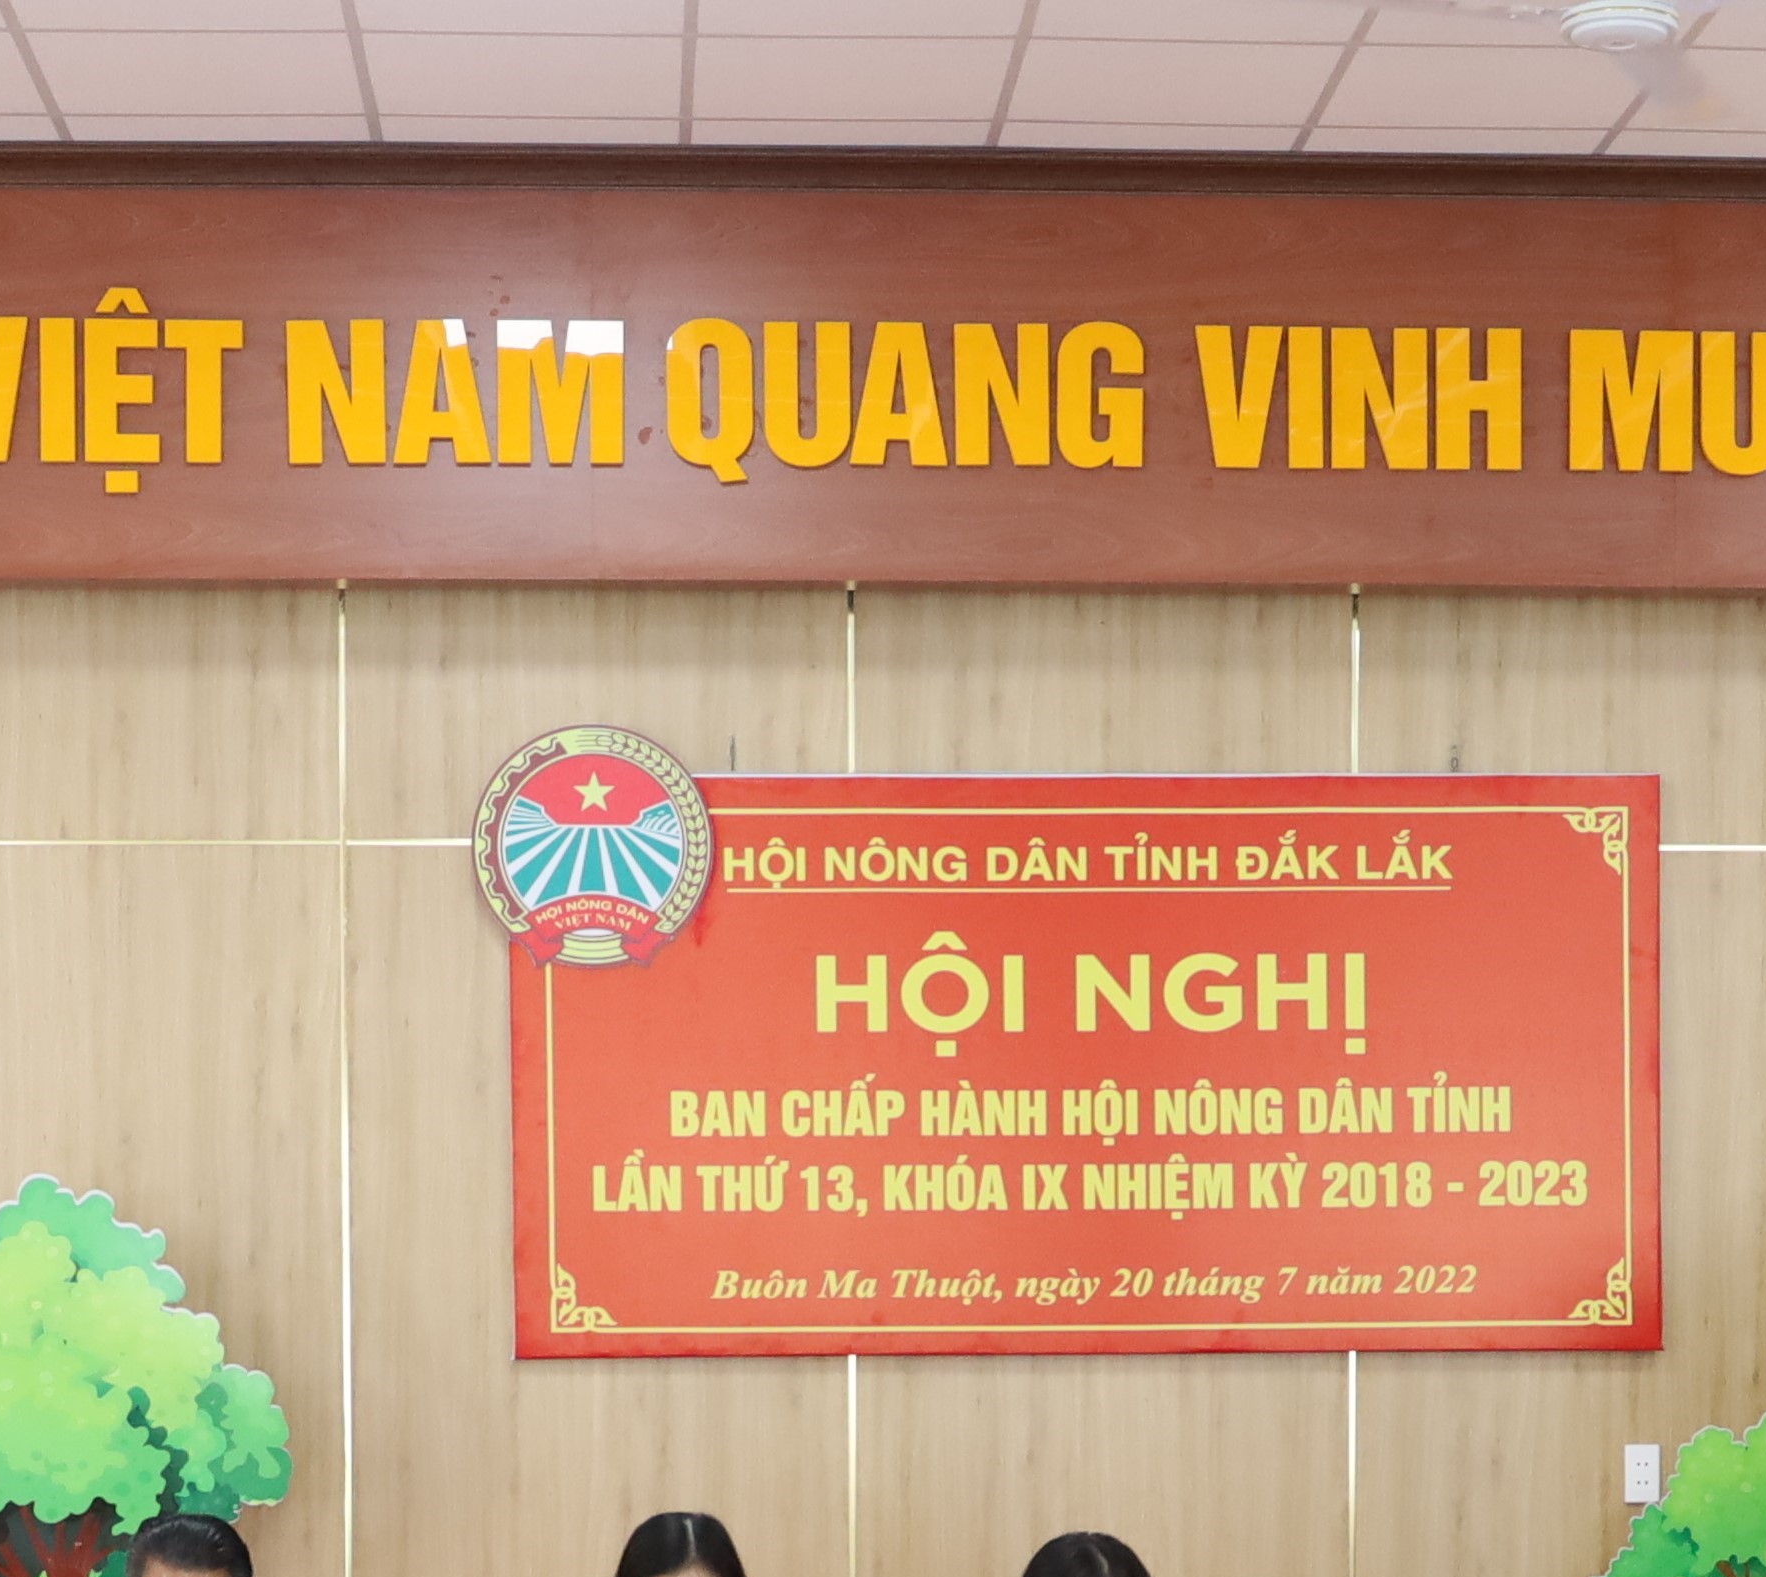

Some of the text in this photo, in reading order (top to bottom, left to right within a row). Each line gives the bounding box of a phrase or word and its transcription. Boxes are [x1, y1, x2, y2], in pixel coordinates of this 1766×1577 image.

[285, 318, 626, 466] NAM
[665, 318, 1145, 483] QUANG
[1195, 325, 1523, 471] VINH
[722, 829, 1453, 888] HỘI NÔNG DÂN TỈNH ĐẮK LẮK
[535, 897, 650, 925] HỘI NÔNG DÂN
[554, 913, 632, 931] VIỆT NAM
[815, 931, 1366, 1057] HỘI NGHỊ
[669, 1070, 1512, 1147] BAN CHẤP HÀNH HỘI NÔNG DÂN TỈNH
[591, 1147, 1589, 1221] LẦN THỨ 13, KHÓA IX NHIỆM KỲ 2018 - 2023
[710, 1263, 1478, 1306] Buôn Ma Thuột, ngày 20 tháng 7 năm 2022
